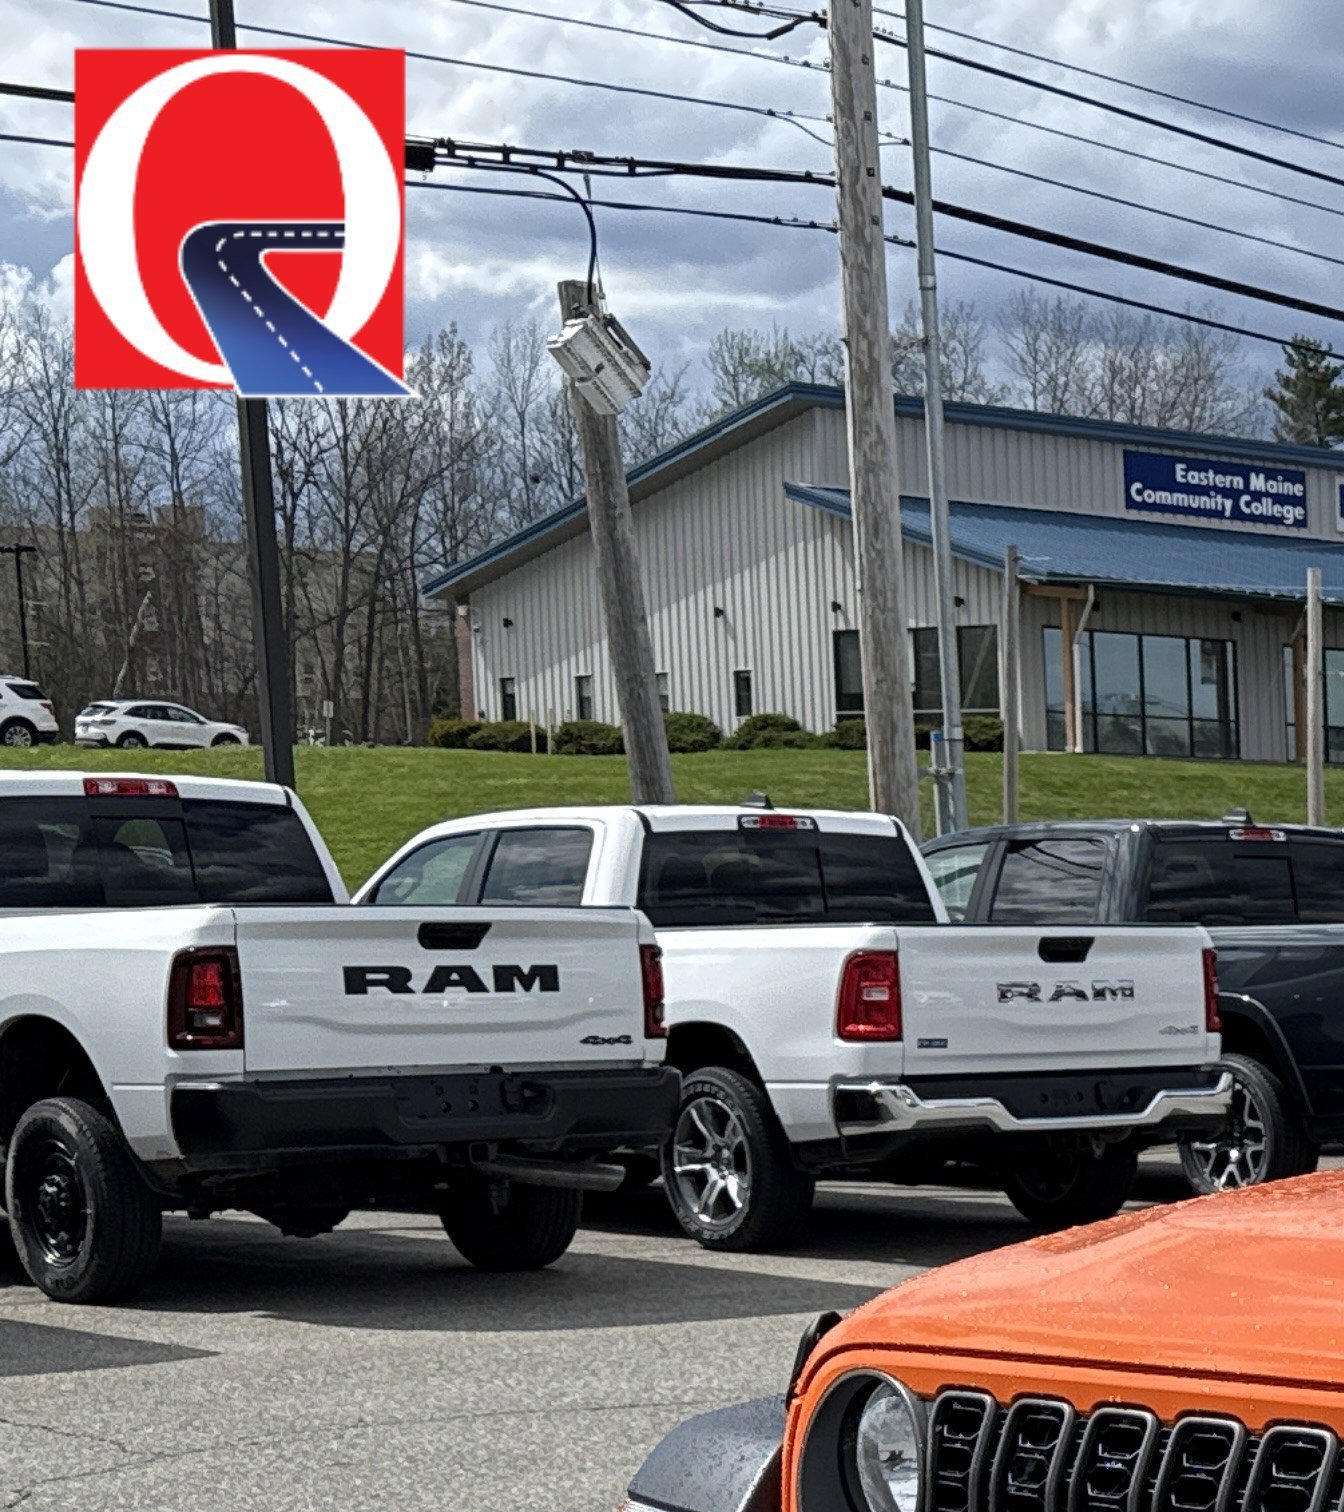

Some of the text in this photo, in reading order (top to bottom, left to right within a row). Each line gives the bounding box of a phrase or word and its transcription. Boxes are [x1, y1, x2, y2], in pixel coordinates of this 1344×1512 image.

[1175, 463, 1304, 497] Eastern Maine
[1130, 481, 1305, 525] Community College
[342, 964, 560, 995] RAM
[996, 979, 1135, 1003] RAM
